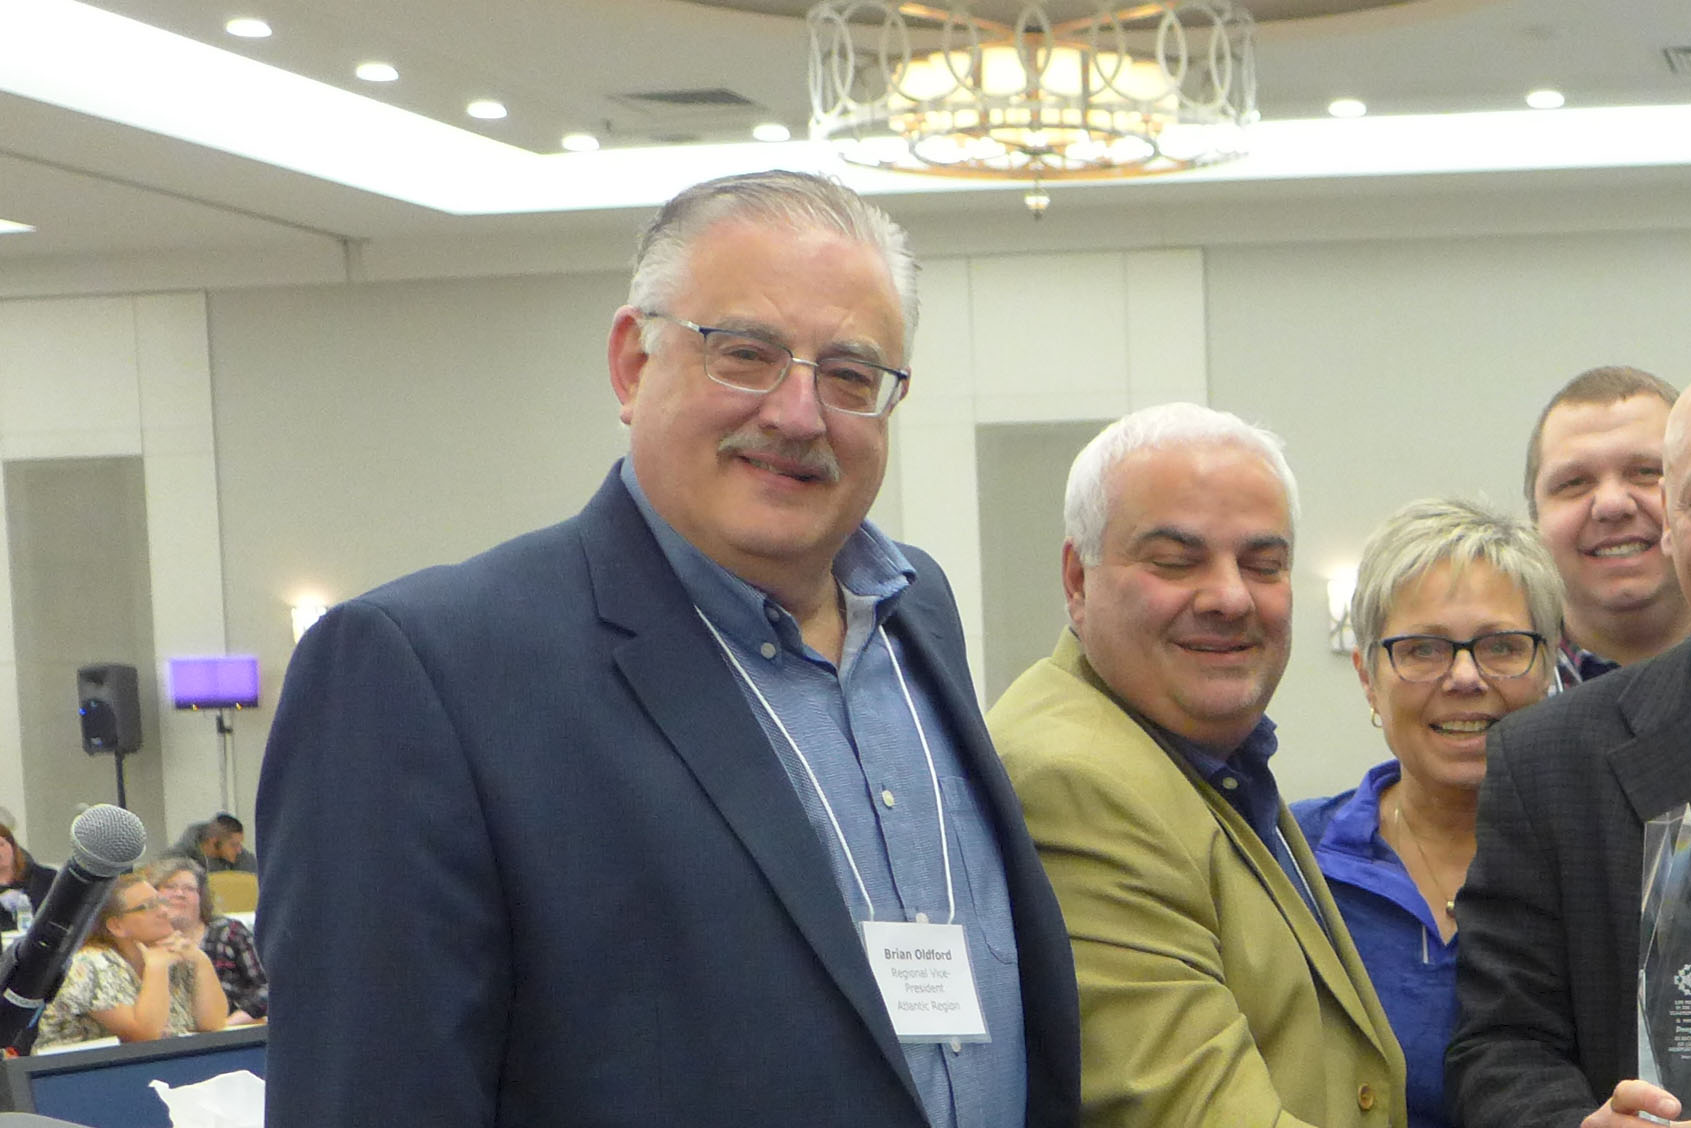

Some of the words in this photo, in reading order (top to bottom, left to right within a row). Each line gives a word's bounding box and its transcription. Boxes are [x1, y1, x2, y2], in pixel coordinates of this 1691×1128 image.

[884, 948, 912, 960] Brian
[915, 949, 952, 960] Oldford
[891, 968, 928, 980] Regional
[905, 983, 944, 993] President
[897, 1001, 929, 1010] Atlantic
[932, 1001, 960, 1012] Region
